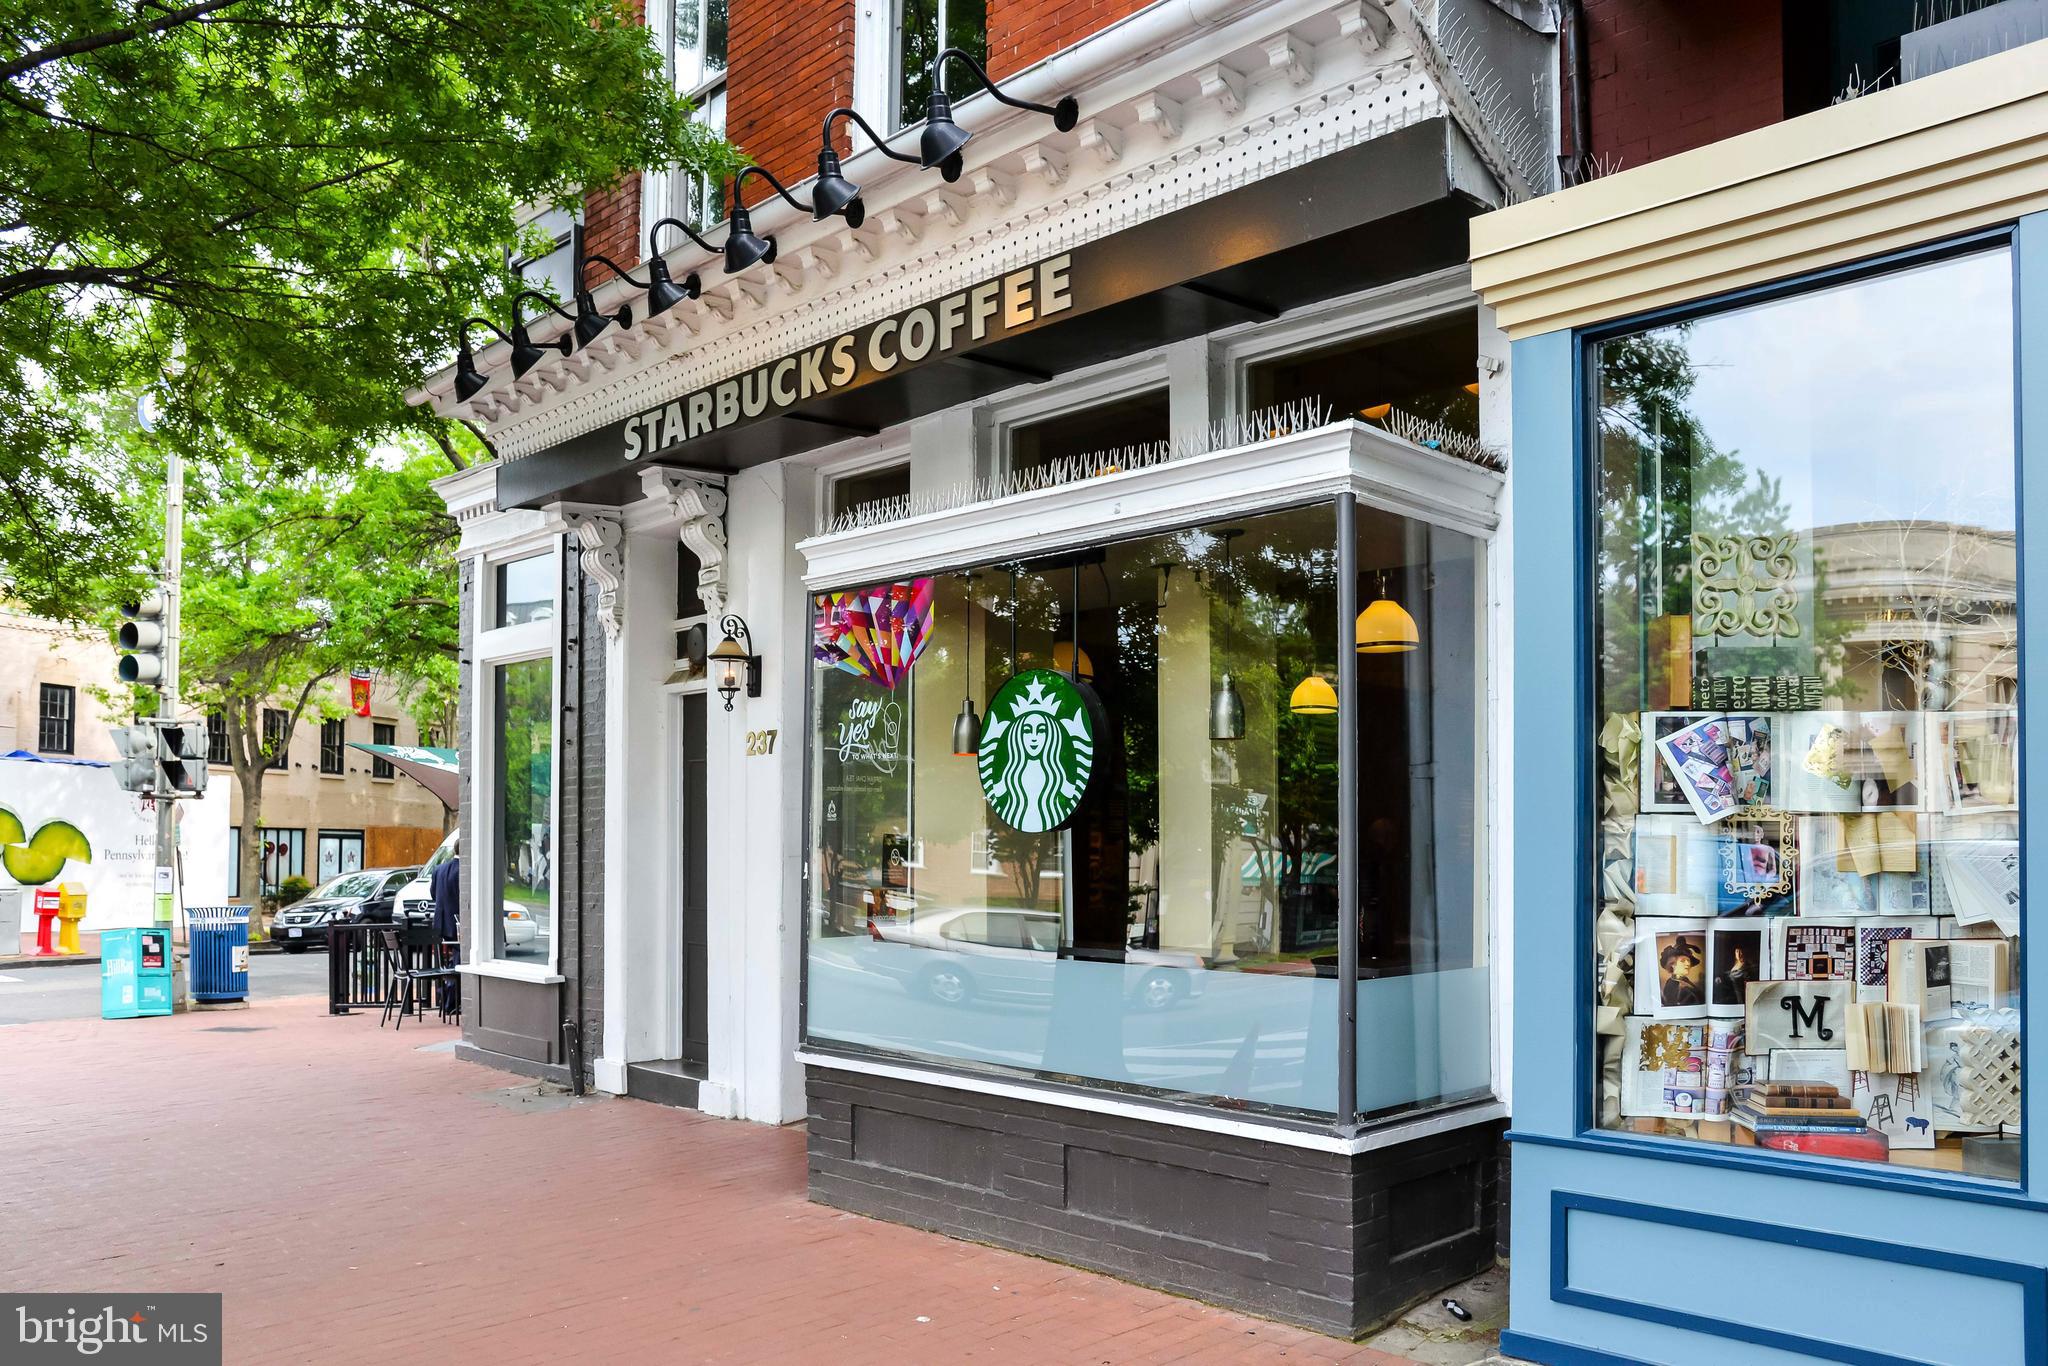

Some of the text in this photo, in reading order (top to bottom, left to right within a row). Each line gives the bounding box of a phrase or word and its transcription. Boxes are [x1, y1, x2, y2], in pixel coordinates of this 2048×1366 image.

[623, 253, 1074, 462] STARBUCKS COFFEE
[745, 730, 778, 756] 237
[135, 834, 156, 846] Hell
[1780, 994, 1833, 1041] M
